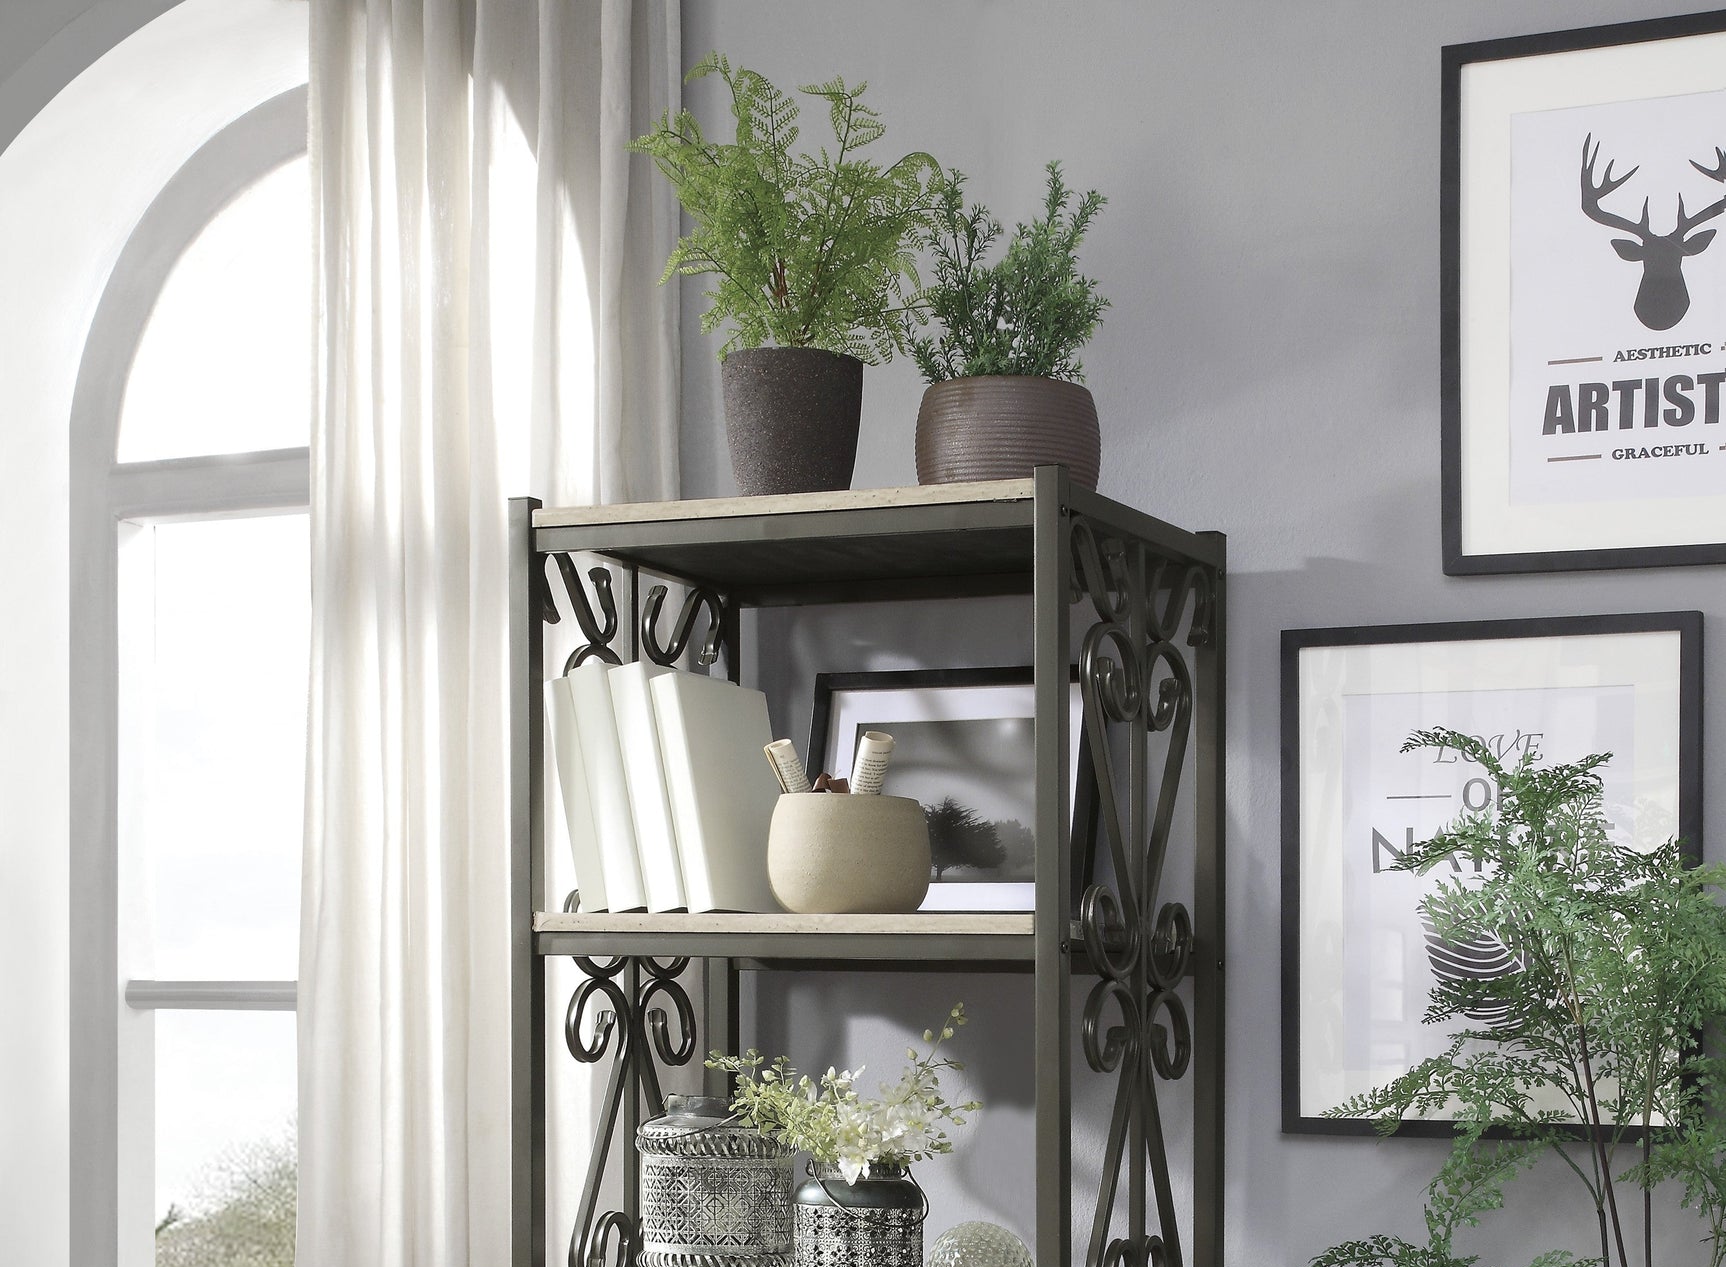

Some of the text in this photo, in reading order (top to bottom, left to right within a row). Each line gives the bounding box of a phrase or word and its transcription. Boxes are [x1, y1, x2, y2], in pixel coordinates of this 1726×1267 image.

[1613, 343, 1712, 363] AESTHETIC
[1542, 371, 1726, 435] ARTIST
[1611, 443, 1709, 460] GRACEFUL
